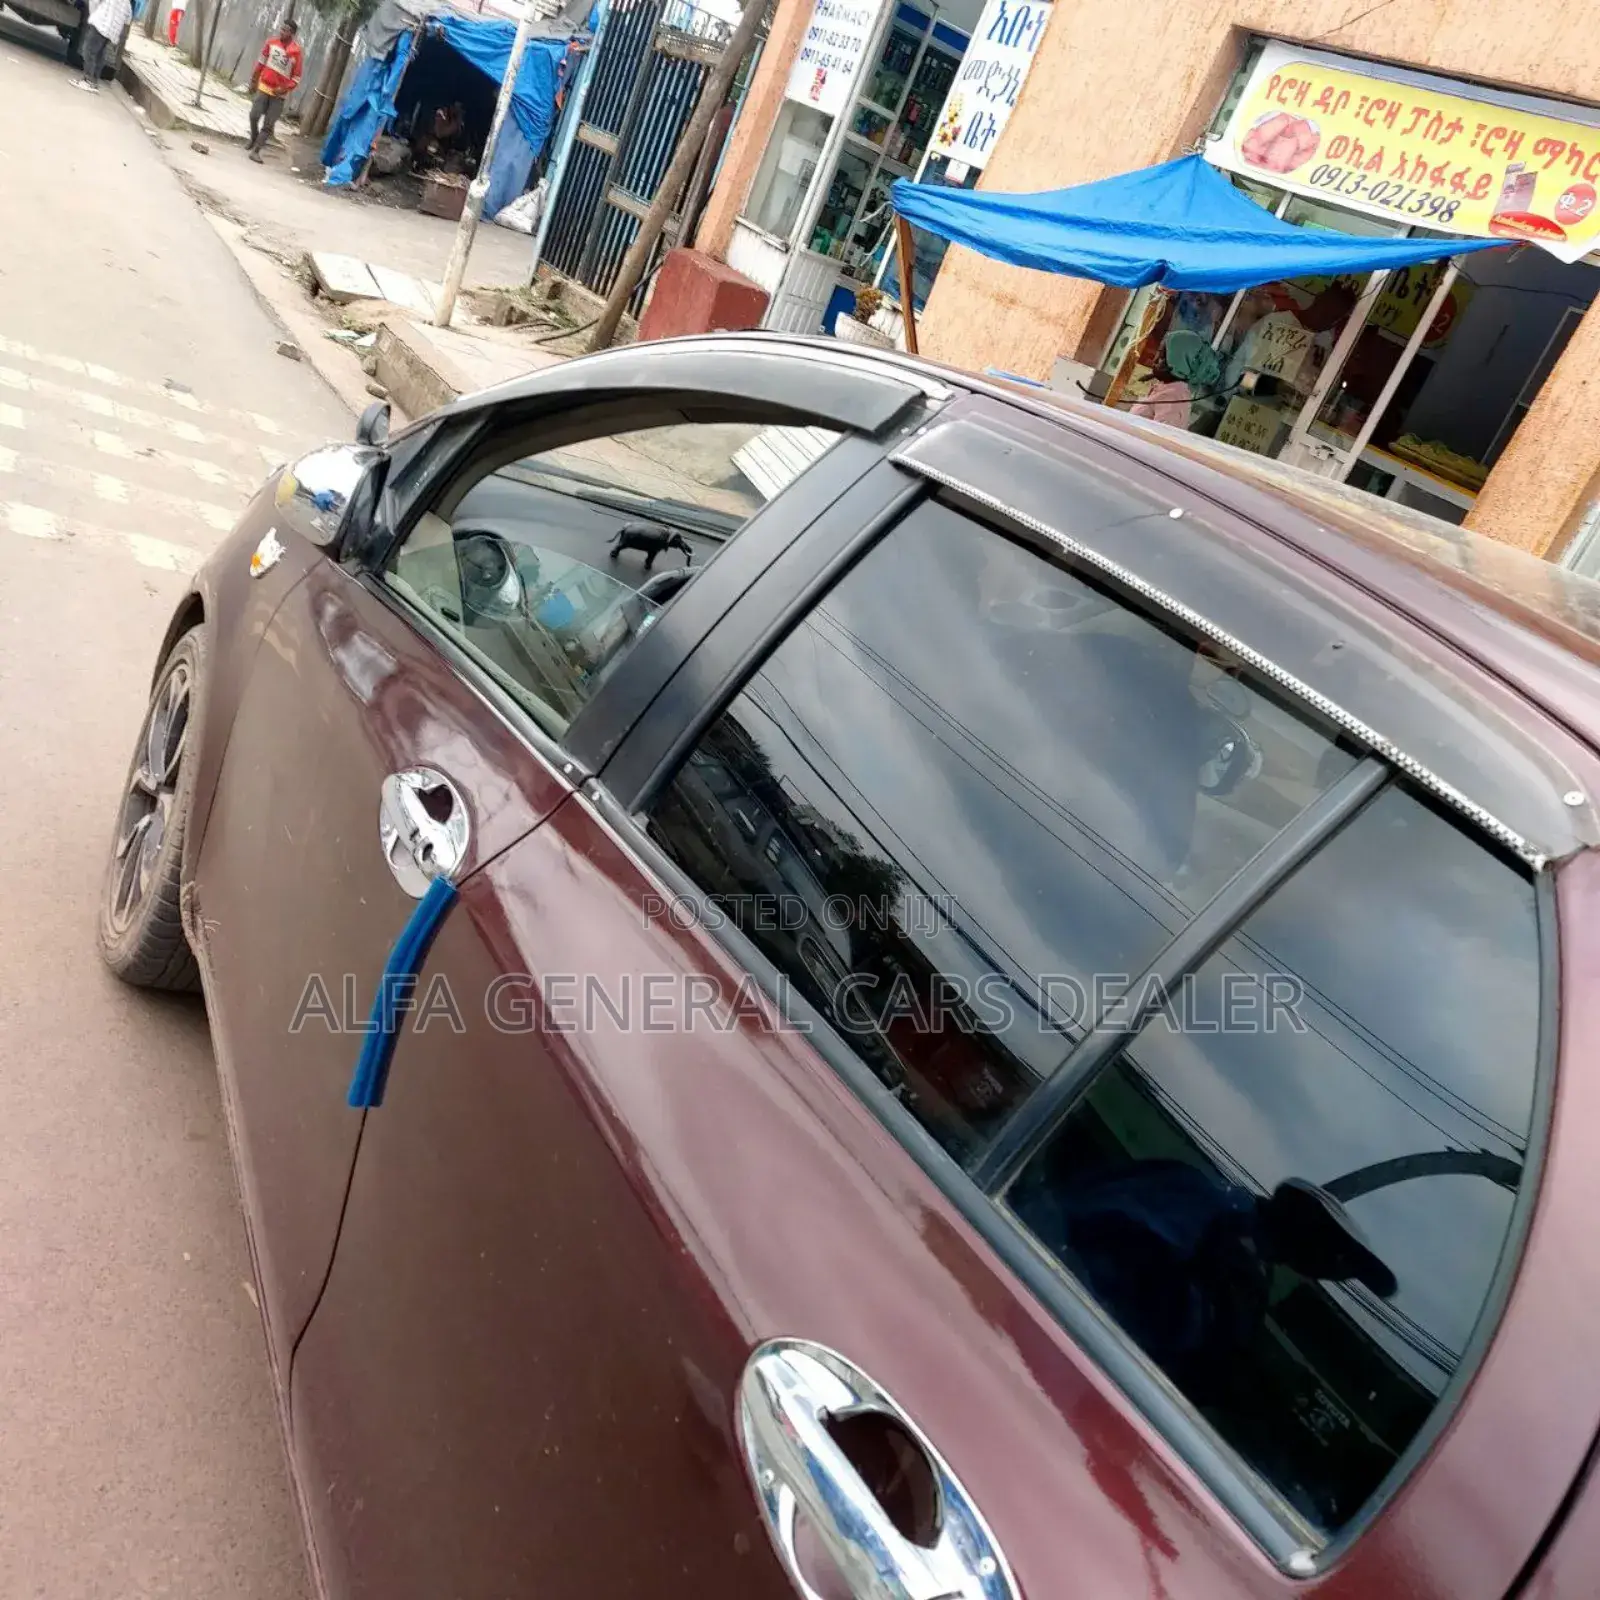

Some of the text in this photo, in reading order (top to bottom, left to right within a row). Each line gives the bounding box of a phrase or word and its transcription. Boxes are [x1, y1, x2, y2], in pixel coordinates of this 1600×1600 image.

[814, 0, 869, 27] PHARMACY
[962, 110, 996, 152] ቤት
[1400, 106, 1464, 146] ፓስታ
[1309, 163, 1462, 224] 0913-021398
